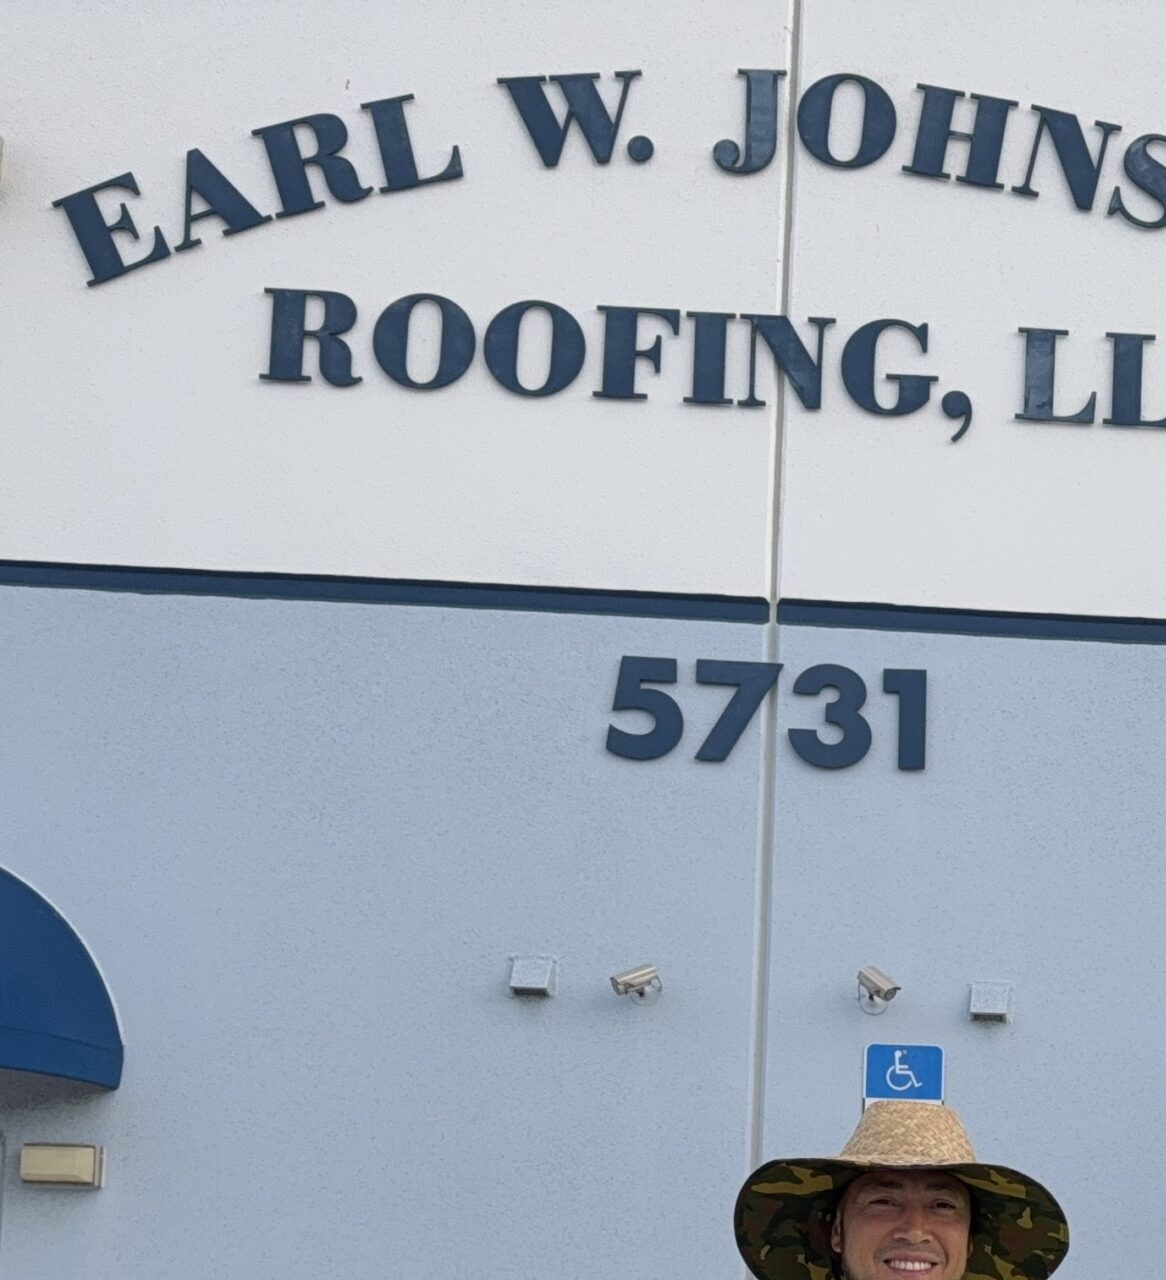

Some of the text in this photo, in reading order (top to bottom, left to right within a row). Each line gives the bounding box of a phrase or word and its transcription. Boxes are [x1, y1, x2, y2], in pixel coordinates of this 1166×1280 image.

[52, 93, 464, 289] EARL
[496, 69, 655, 170] W.
[258, 287, 973, 443] ROOFING,
[605, 655, 928, 772] 5731
